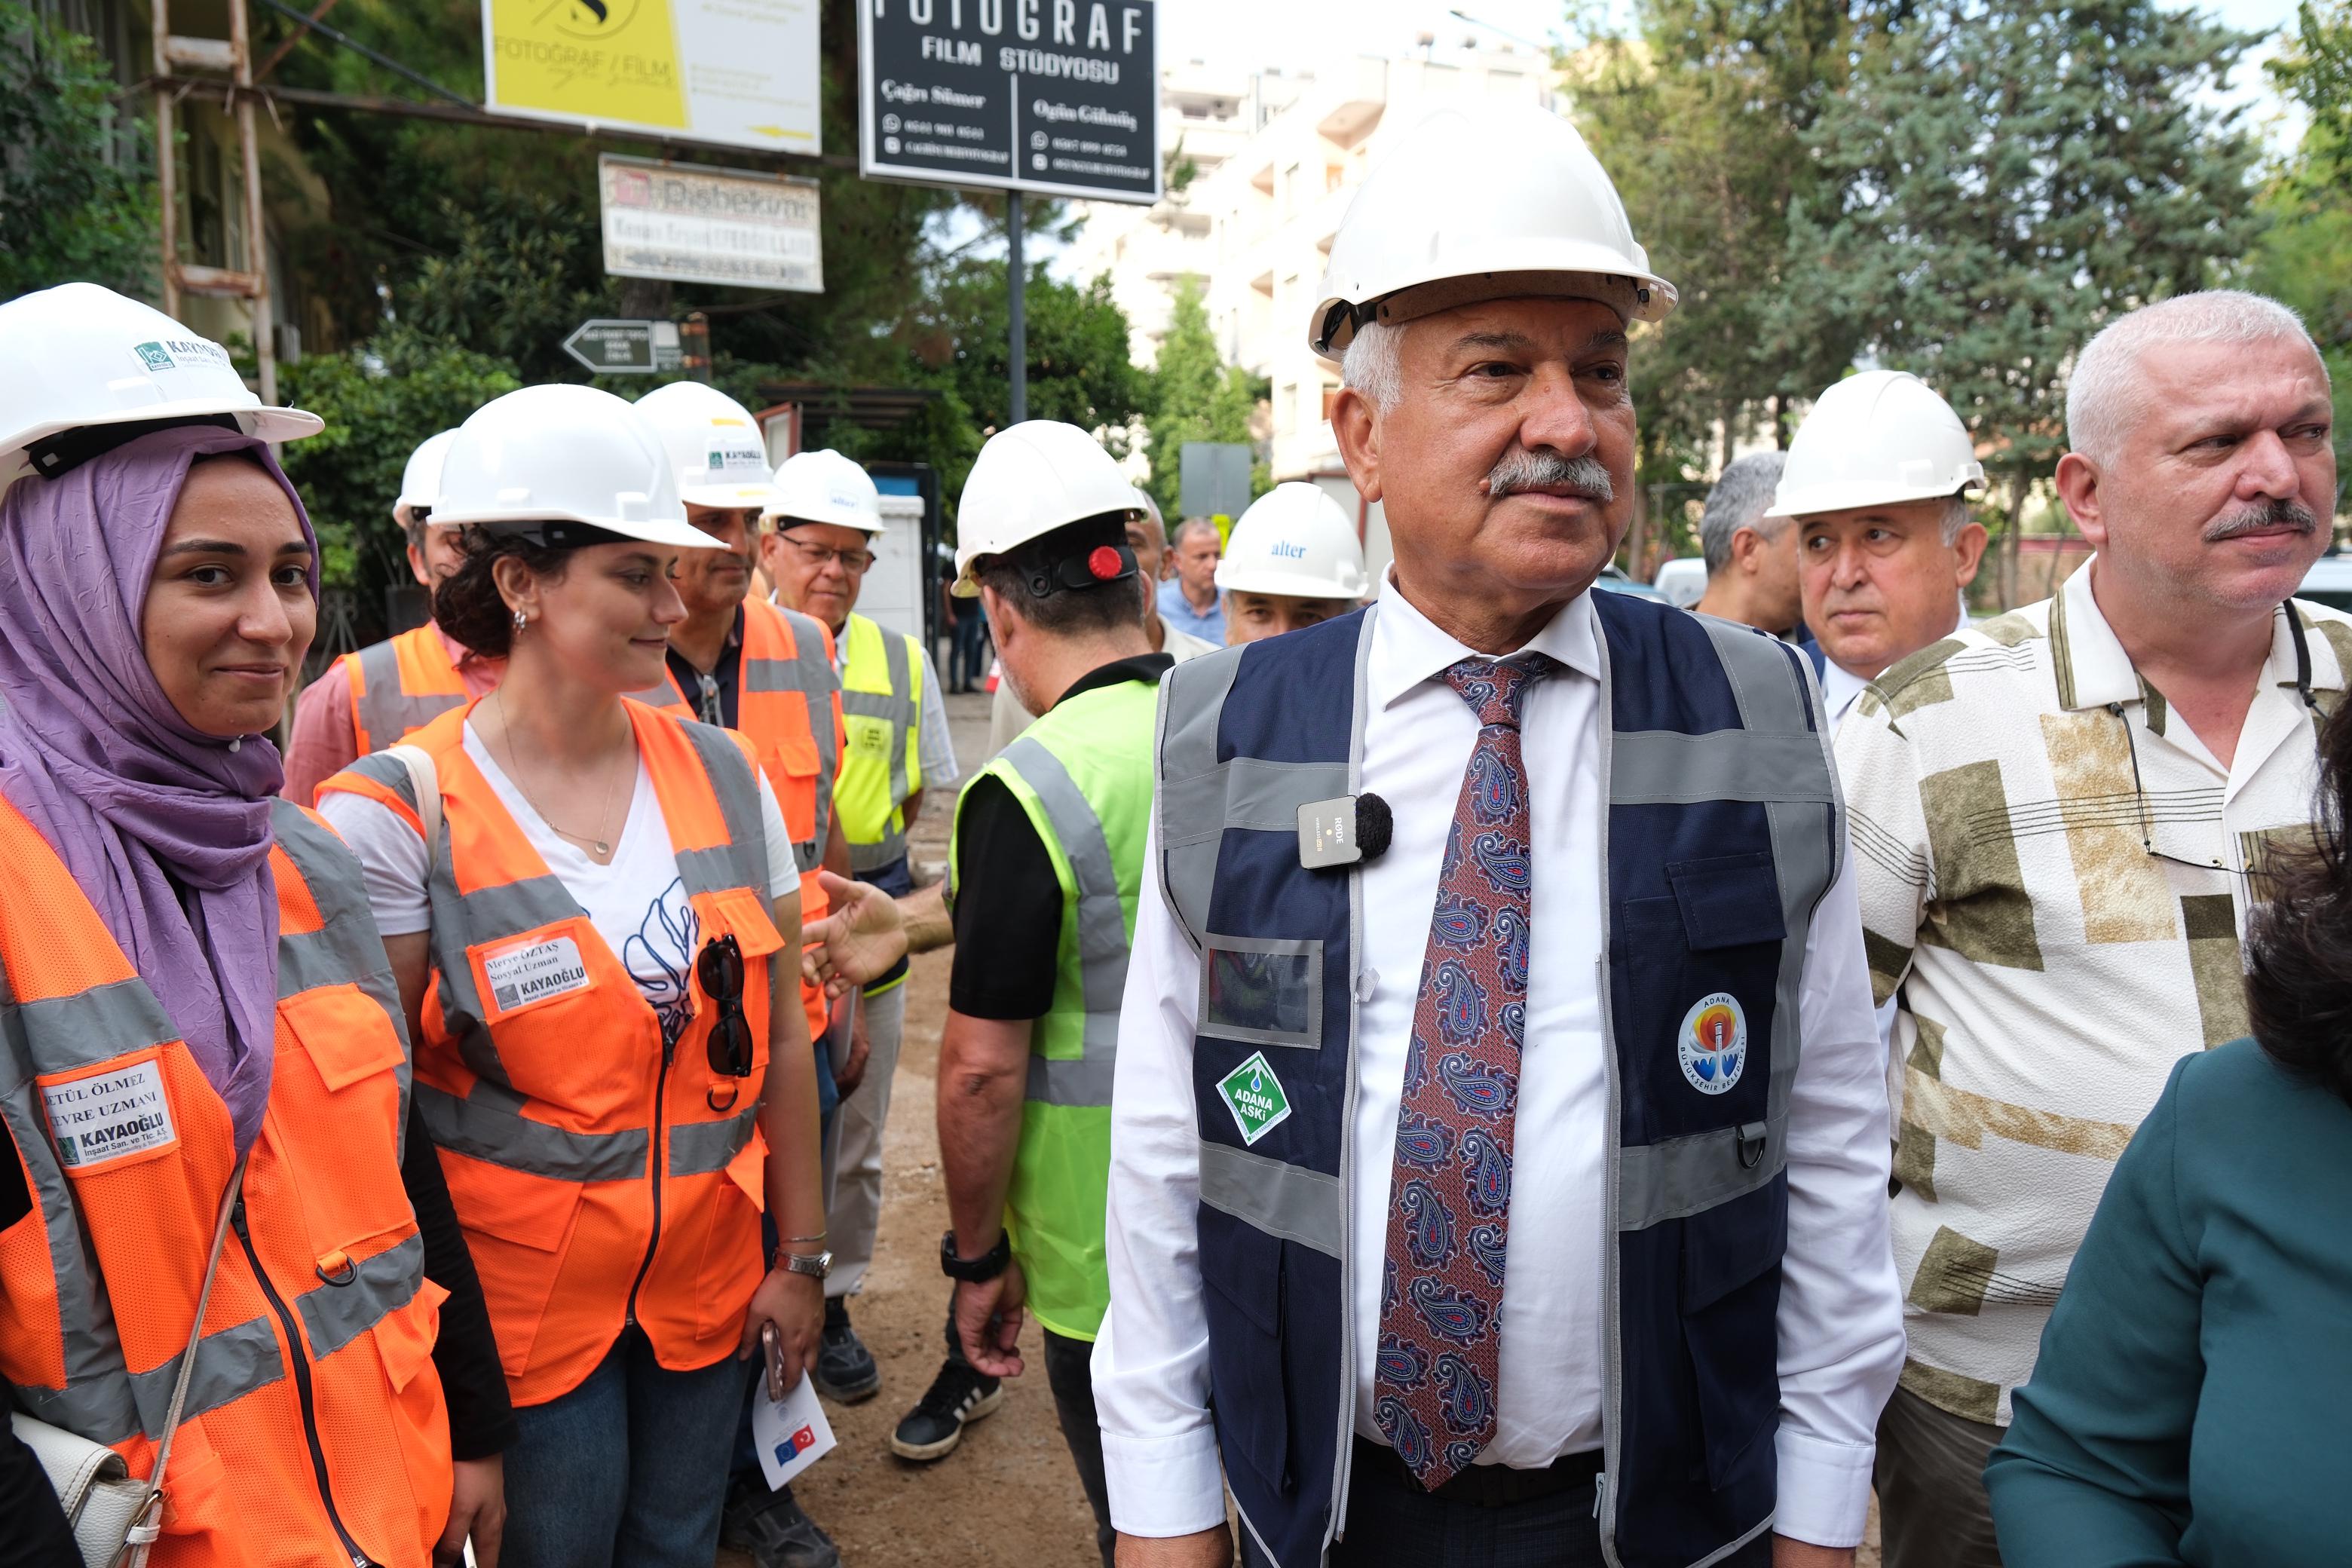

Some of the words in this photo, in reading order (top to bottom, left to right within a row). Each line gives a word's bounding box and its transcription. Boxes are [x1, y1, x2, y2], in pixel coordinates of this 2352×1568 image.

[1000, 47, 1119, 84] STÜDYOSU
[1271, 539, 1306, 559] alter
[1334, 816, 1344, 844] RØDE
[486, 954, 519, 972] Merve
[520, 942, 559, 960] ÖZTAŞ
[490, 965, 522, 982] Sosyal
[524, 957, 559, 972] Uzman
[520, 966, 585, 995] KAYAOĞLU
[1704, 996, 1730, 1008] ADANA
[91, 1073, 145, 1096] ÖLMEZ
[100, 1092, 157, 1116] UZMANI
[1235, 1088, 1272, 1112] ADANA
[80, 1112, 164, 1147] KAYAOĞLU
[111, 1139, 129, 1150] San.
